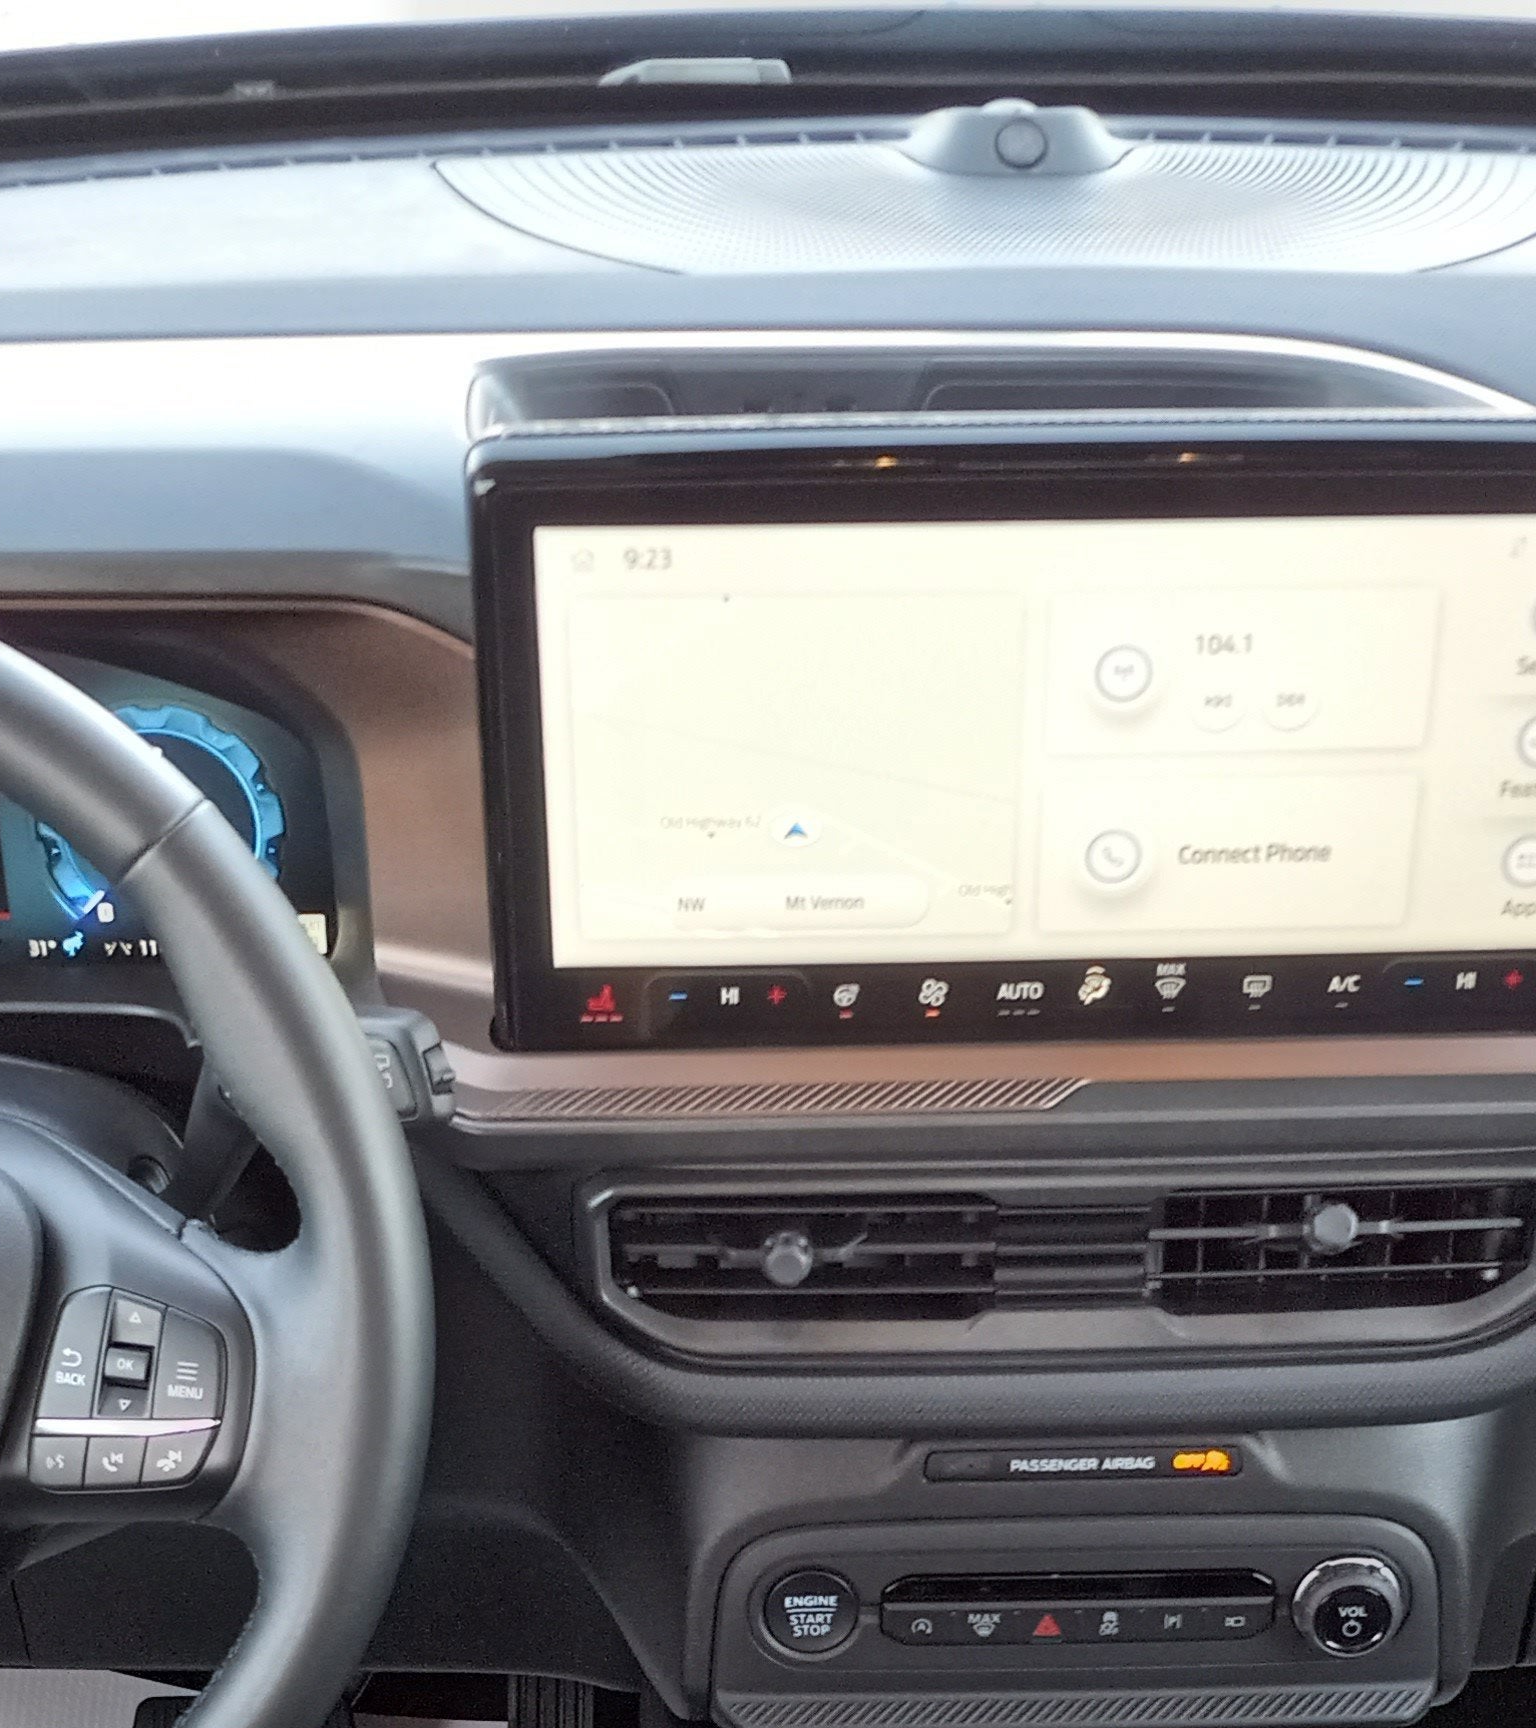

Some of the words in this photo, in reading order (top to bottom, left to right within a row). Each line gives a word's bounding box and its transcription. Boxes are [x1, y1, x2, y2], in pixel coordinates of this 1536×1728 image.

[624, 547, 673, 570] 9:23
[1195, 633, 1253, 655] 104.1
[1178, 844, 1262, 866] Connect
[1266, 841, 1331, 864] Phone
[677, 896, 705, 913] NW
[785, 893, 807, 911] Mt
[810, 892, 865, 911] Vernon
[997, 981, 1045, 1001] AUTO
[1328, 974, 1361, 994] A/C
[116, 1356, 134, 1372] OK
[54, 1370, 86, 1387] BACK
[167, 1384, 203, 1401] MENU
[1009, 1459, 1100, 1473] PASSENGER
[1101, 1456, 1156, 1471] AIRBAG
[784, 1595, 839, 1608] ENGINE
[789, 1613, 834, 1625] START
[967, 1612, 1002, 1625] MAX
[1338, 1605, 1369, 1618] VOL
[793, 1624, 832, 1637] STOP
